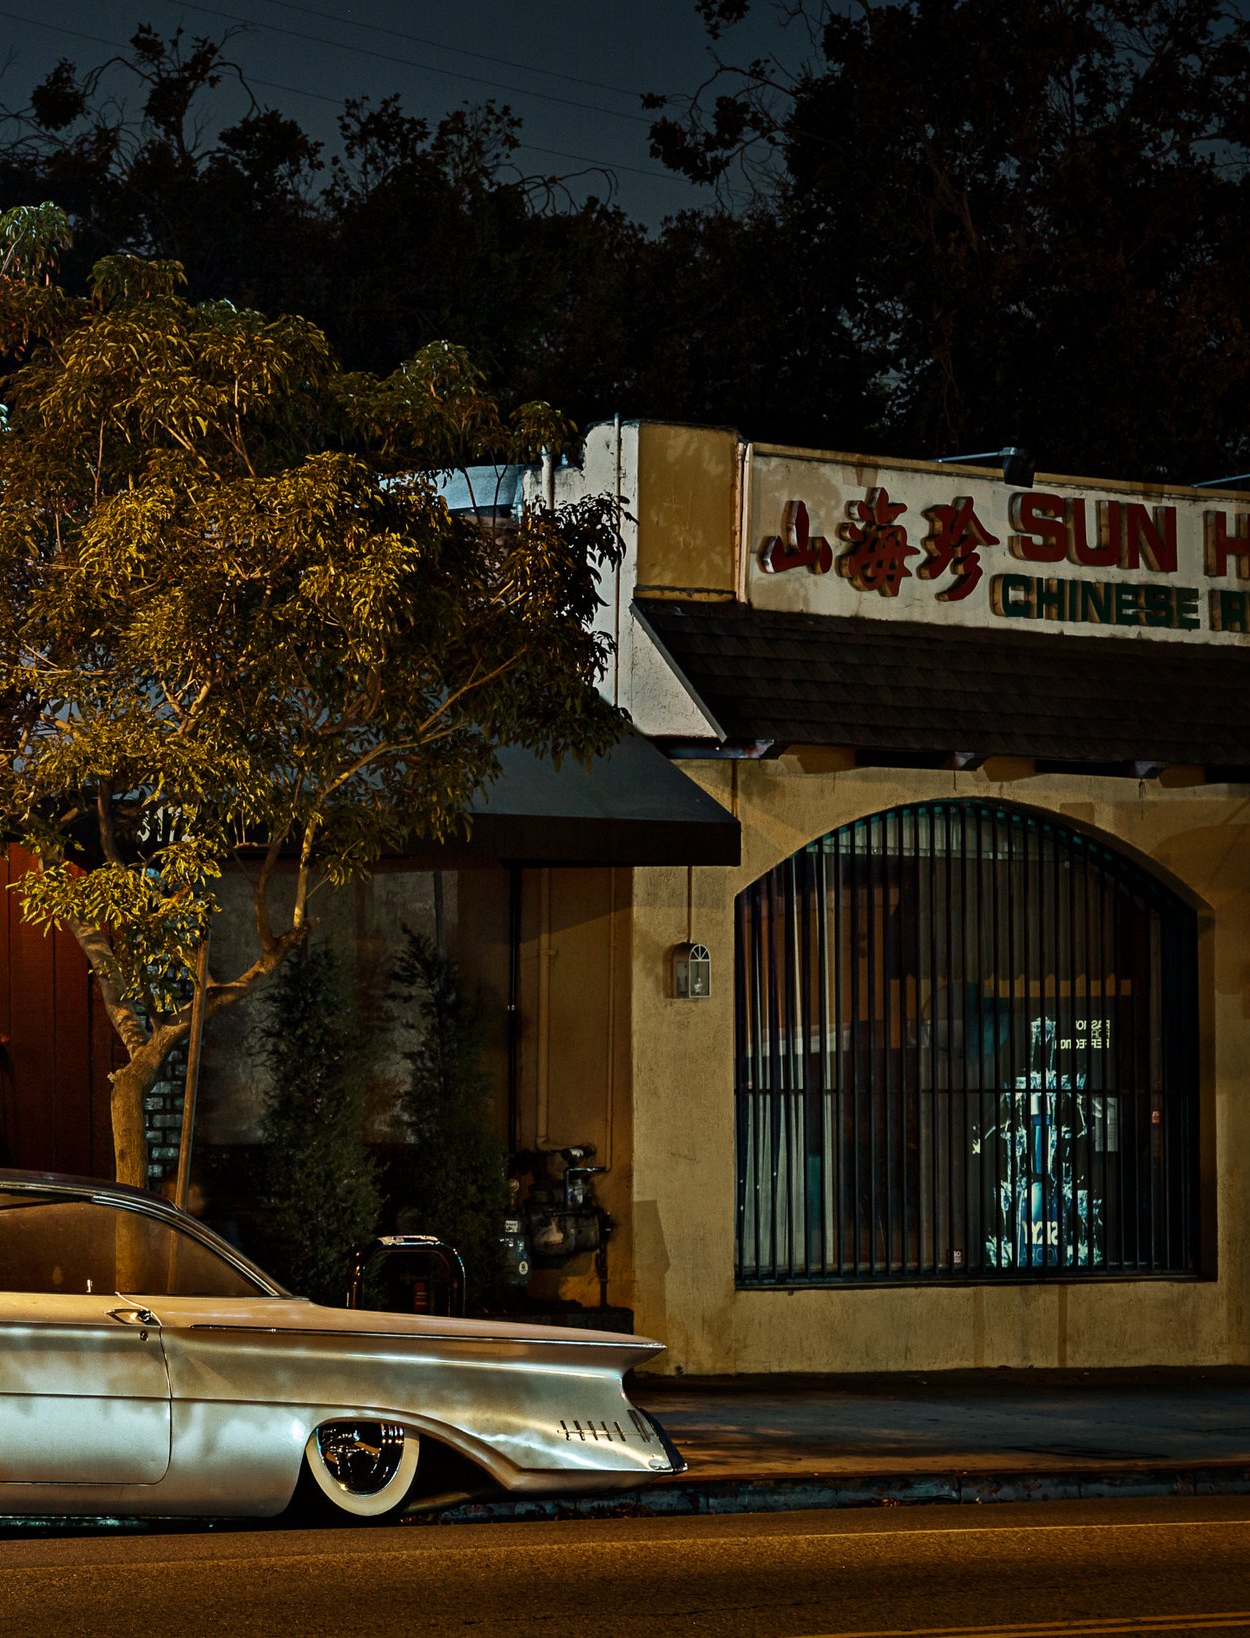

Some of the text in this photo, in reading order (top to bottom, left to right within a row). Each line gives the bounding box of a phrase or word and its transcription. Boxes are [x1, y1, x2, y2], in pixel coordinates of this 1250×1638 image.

[1008, 492, 1178, 572] SUN
[990, 574, 1250, 633] CHINESE R
